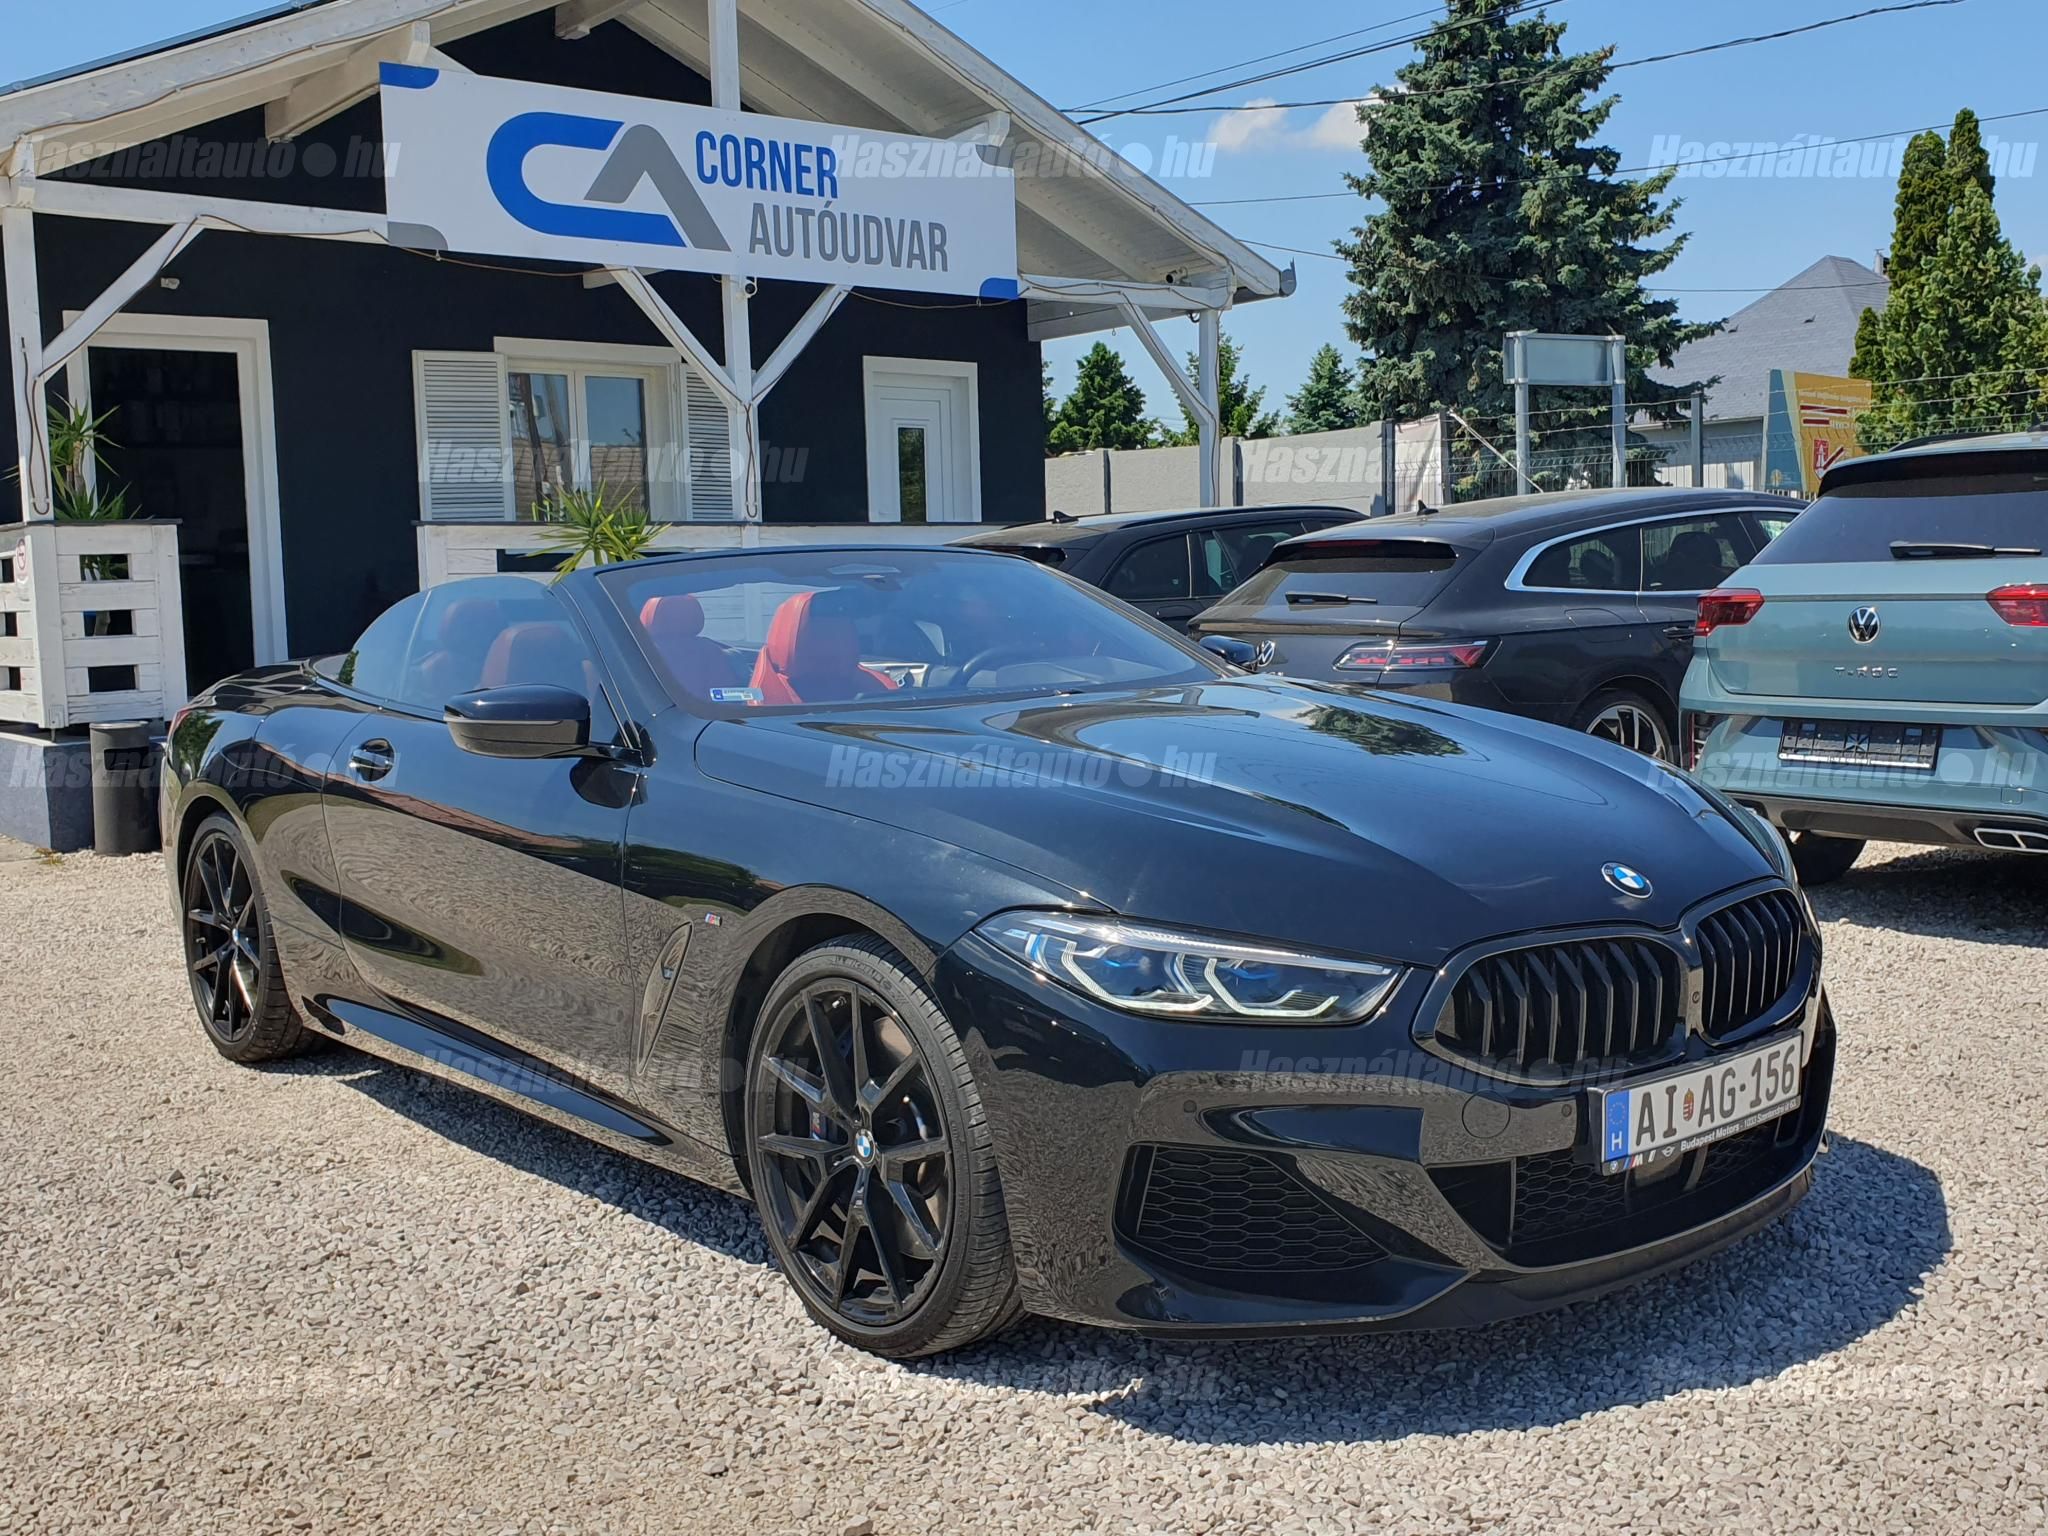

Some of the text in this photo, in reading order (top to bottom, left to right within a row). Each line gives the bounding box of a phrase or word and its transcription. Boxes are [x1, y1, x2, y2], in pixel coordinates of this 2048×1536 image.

[695, 130, 839, 200] CORNER
[748, 201, 949, 273] AUTÓUDVAR
[1611, 1131, 1622, 1152] H
[1635, 1084, 1677, 1146] AI
